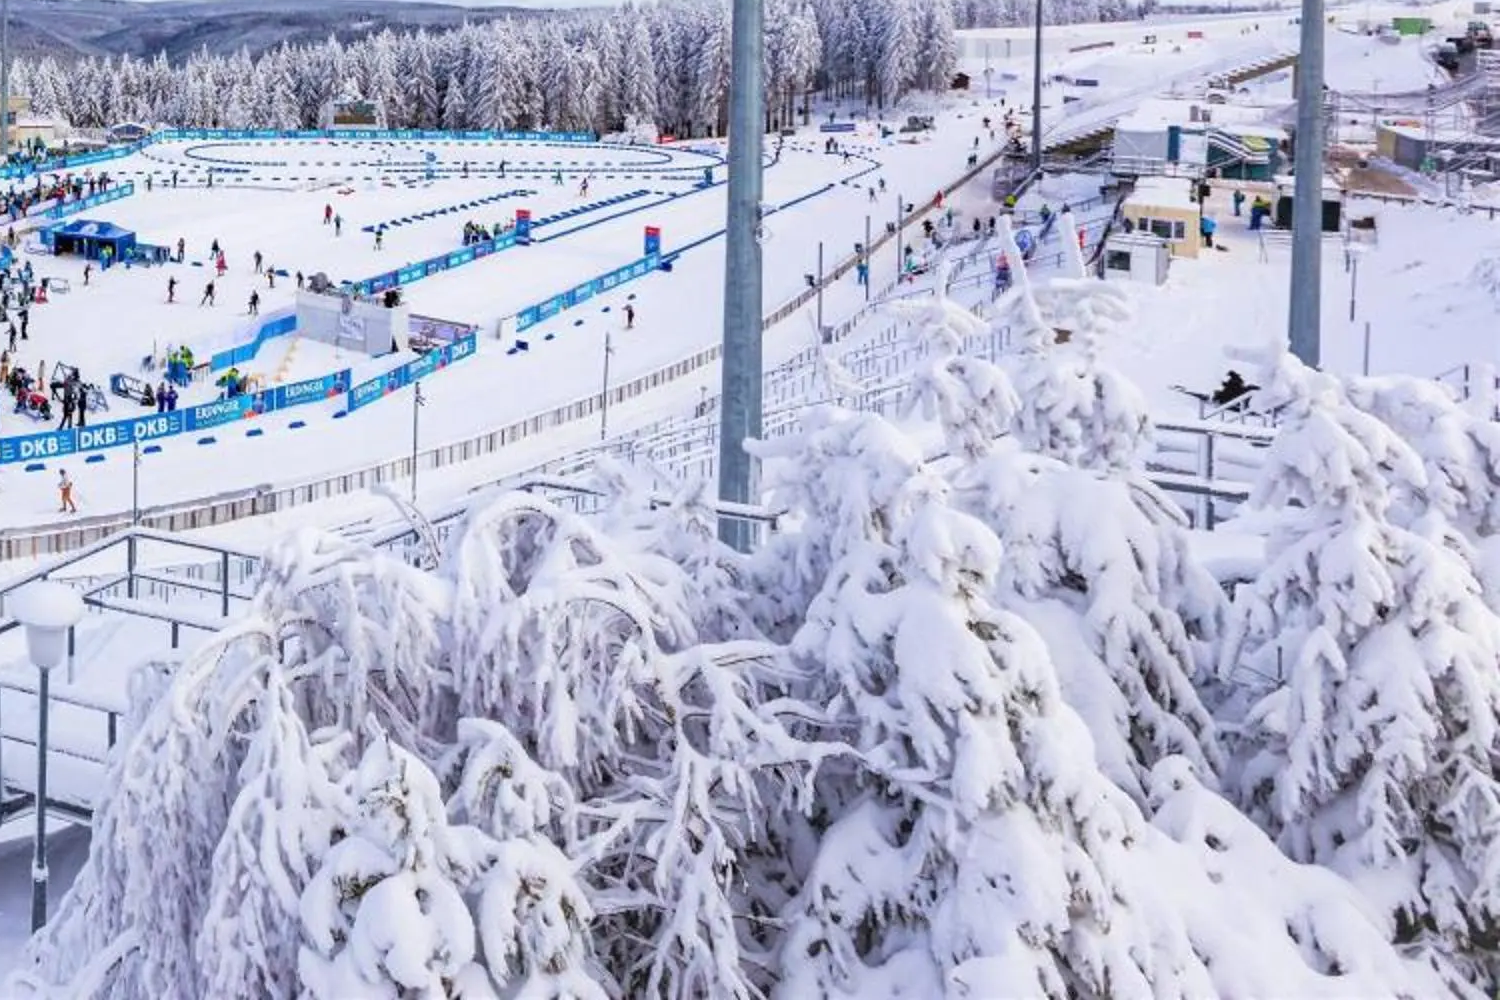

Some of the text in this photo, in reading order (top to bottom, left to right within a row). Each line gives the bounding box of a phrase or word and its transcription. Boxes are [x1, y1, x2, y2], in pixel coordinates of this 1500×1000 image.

[80, 427, 116, 448] DKB
[134, 418, 168, 438] DKB
[21, 436, 58, 457] DKB
